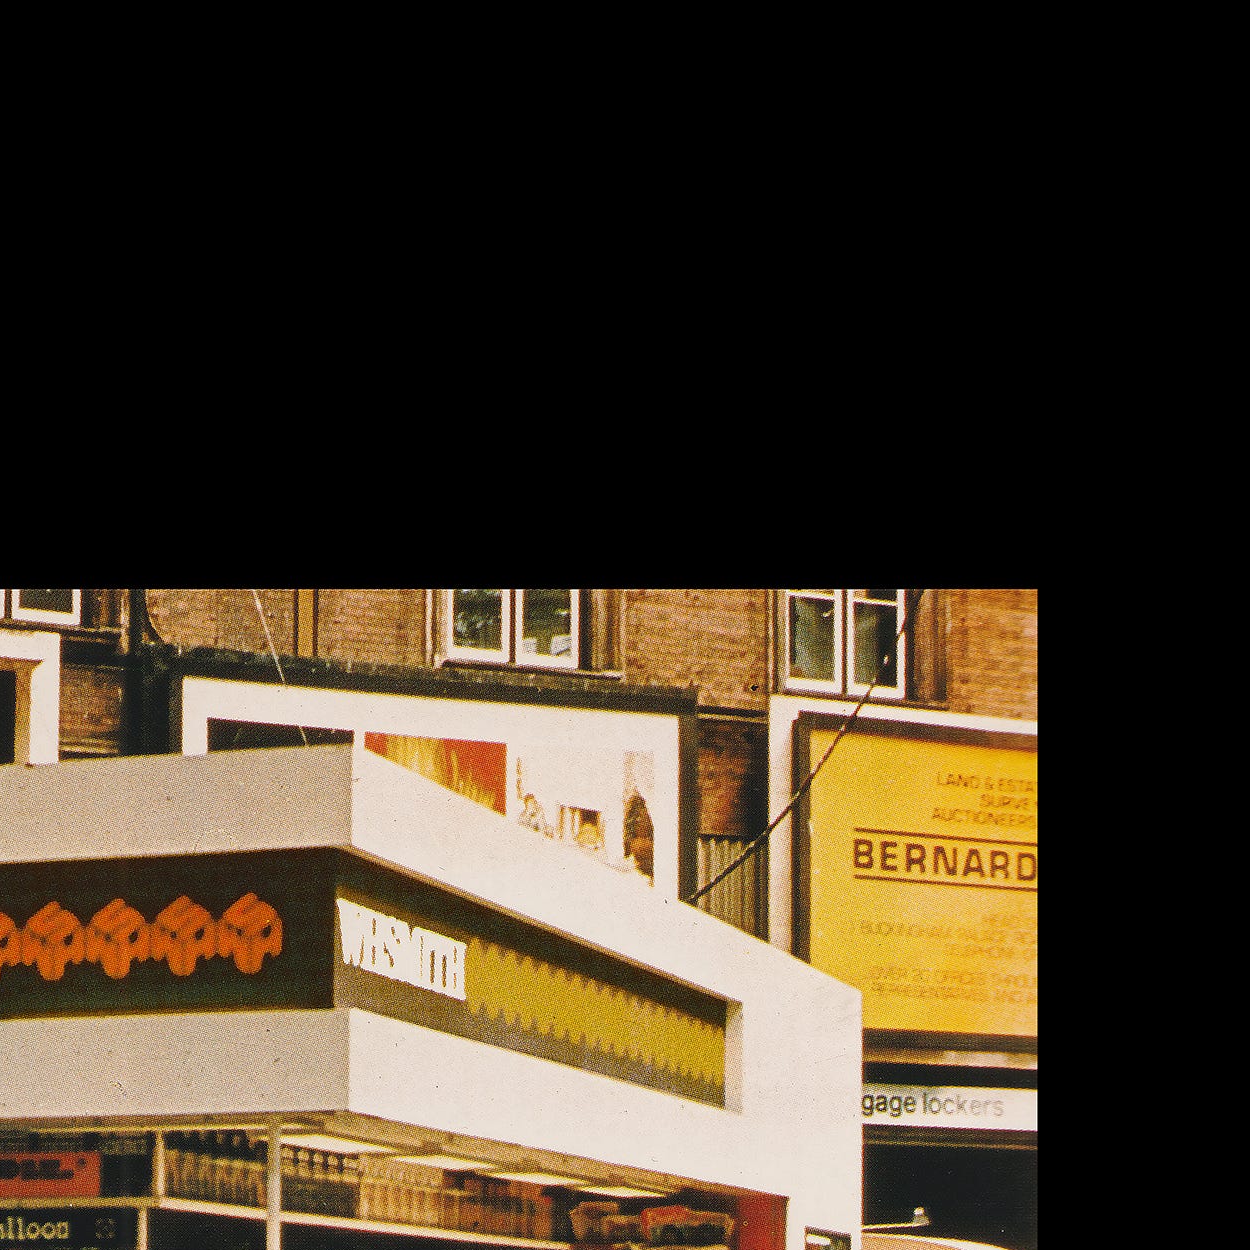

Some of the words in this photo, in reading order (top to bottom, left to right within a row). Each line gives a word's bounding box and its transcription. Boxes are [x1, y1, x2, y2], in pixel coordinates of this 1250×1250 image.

[936, 772, 980, 789] LAND
[998, 778, 1037, 793] ESTA
[853, 838, 1037, 882] BERNARD
[337, 899, 467, 1001] WHSMITH
[862, 1094, 916, 1118] gage
[922, 1091, 1004, 1117] lockers
